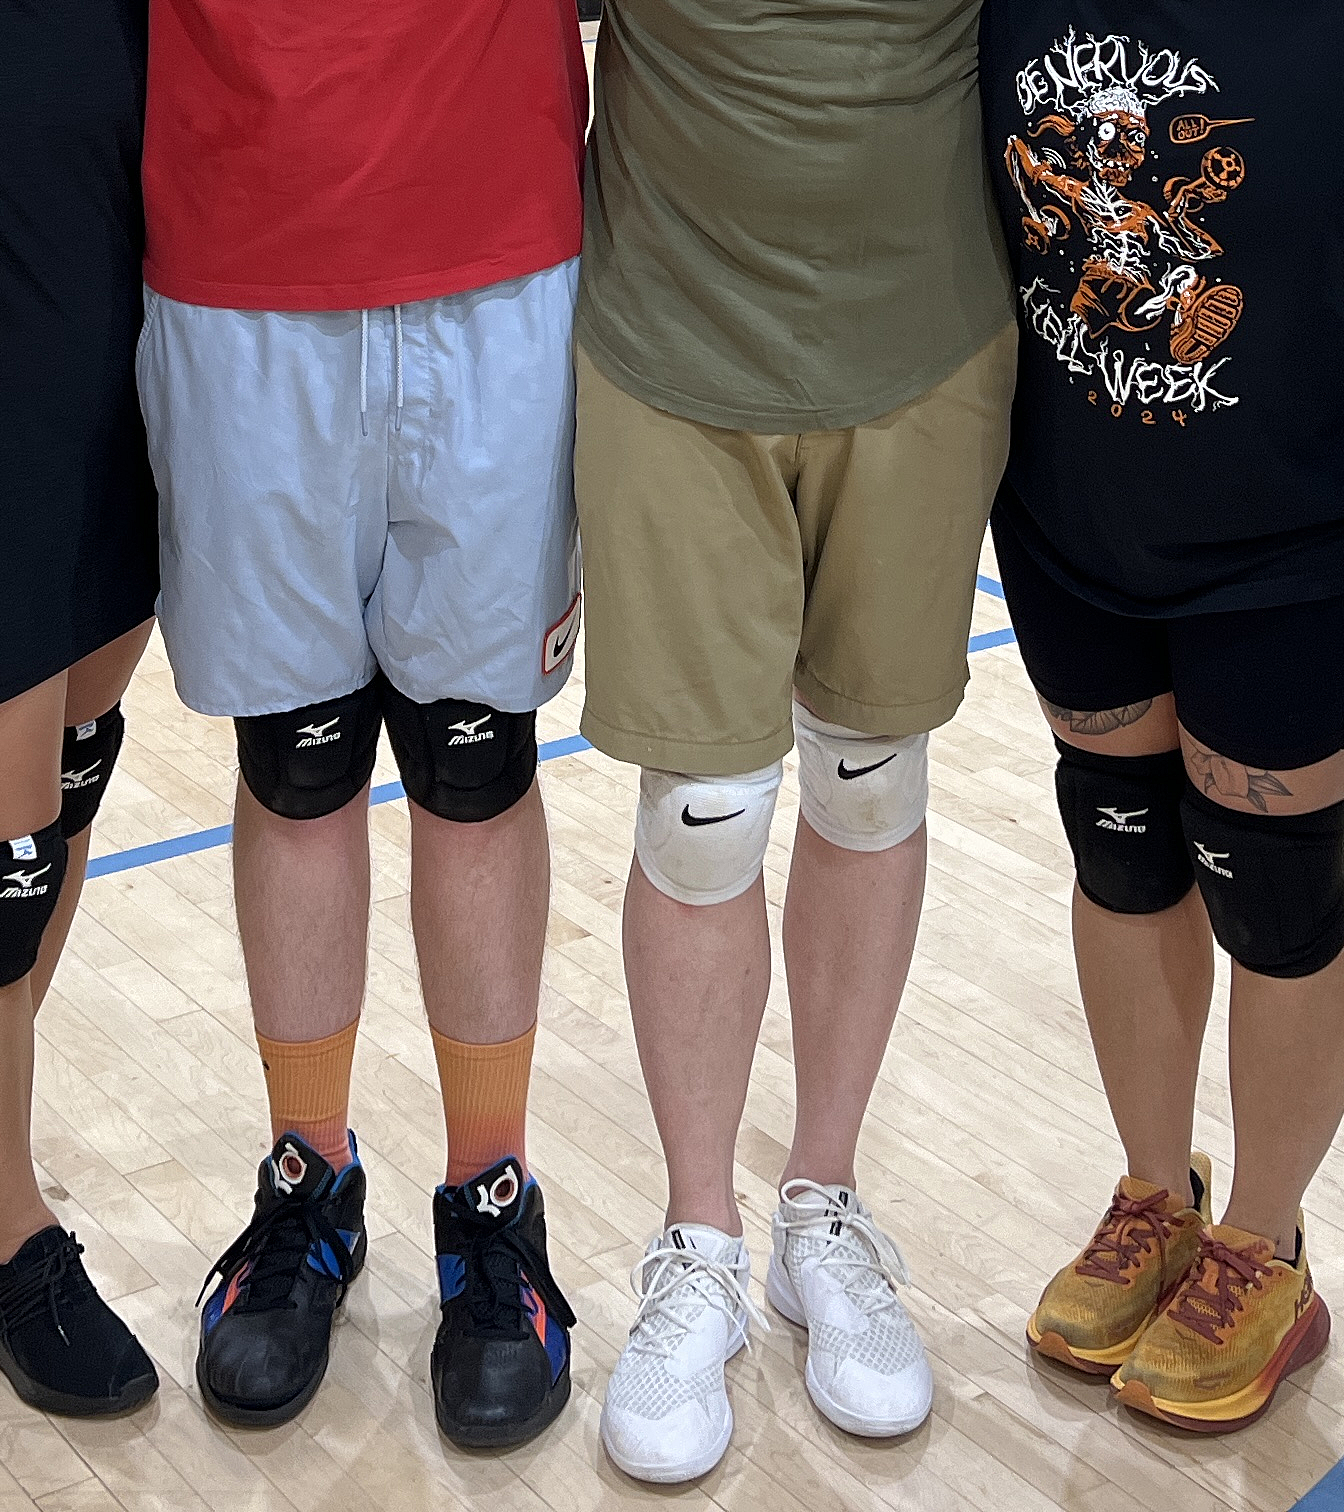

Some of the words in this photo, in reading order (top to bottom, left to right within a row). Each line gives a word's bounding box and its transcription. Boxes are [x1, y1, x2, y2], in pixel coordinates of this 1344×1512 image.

[1016, 59, 1049, 115] BE
[1044, 25, 1221, 94] NERVOUS
[1176, 119, 1198, 131] ALL
[1096, 337, 1239, 413] WEEK
[1087, 390, 1188, 428] 2024
